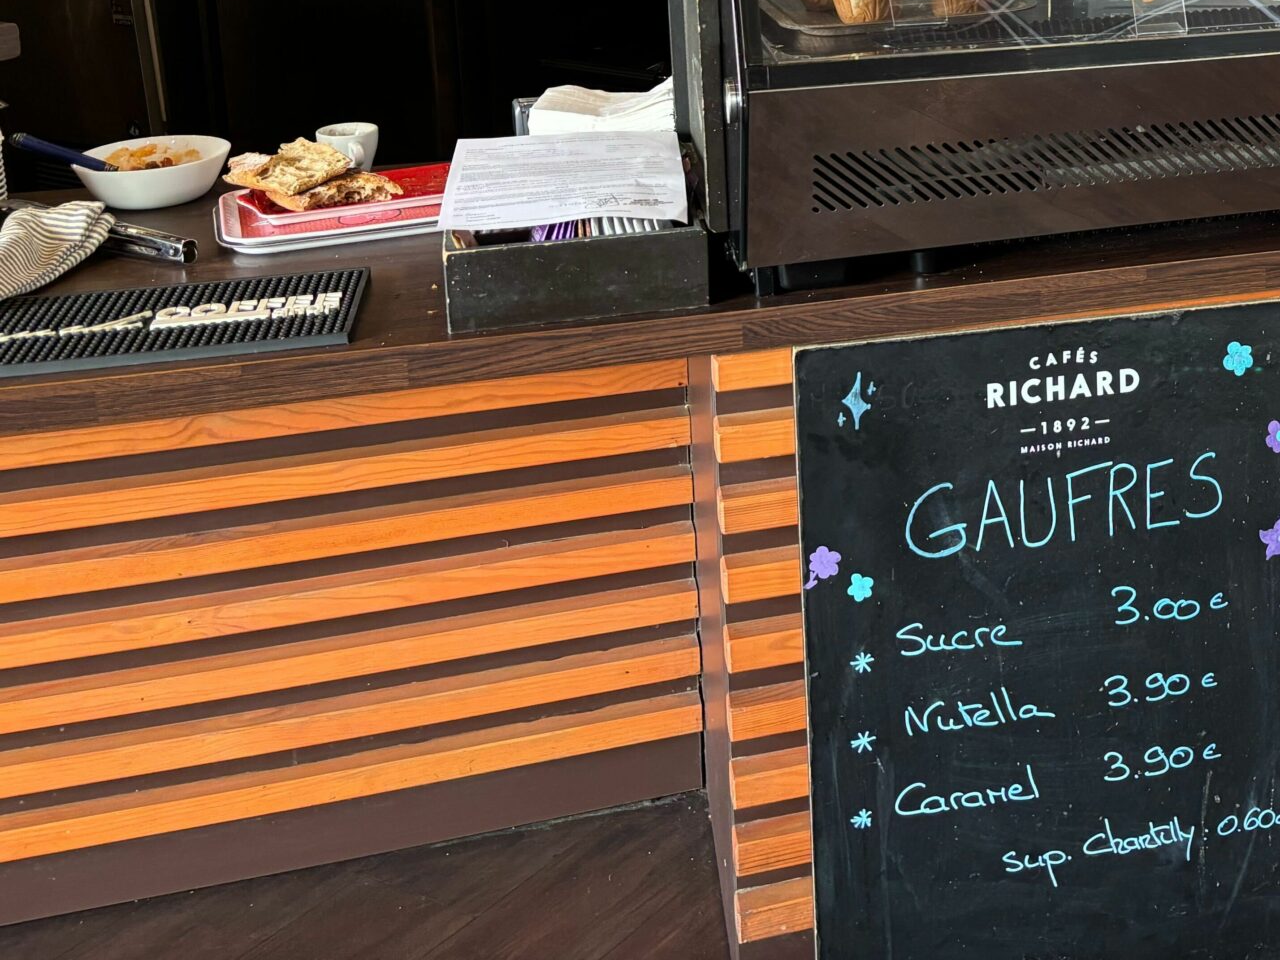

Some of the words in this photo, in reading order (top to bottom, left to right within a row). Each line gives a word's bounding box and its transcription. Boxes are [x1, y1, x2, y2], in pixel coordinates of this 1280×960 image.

[1029, 346, 1099, 371] CAFÉS
[986, 367, 1141, 410] RICHARD
[1041, 416, 1091, 435] 1892
[1020, 442, 1063, 455] MAISON
[1067, 436, 1111, 450] RICHARD
[904, 452, 1223, 559] GAUFRES
[896, 621, 1024, 657] Sucre
[904, 686, 1056, 737] Nutella
[894, 765, 1042, 817] Caramel
